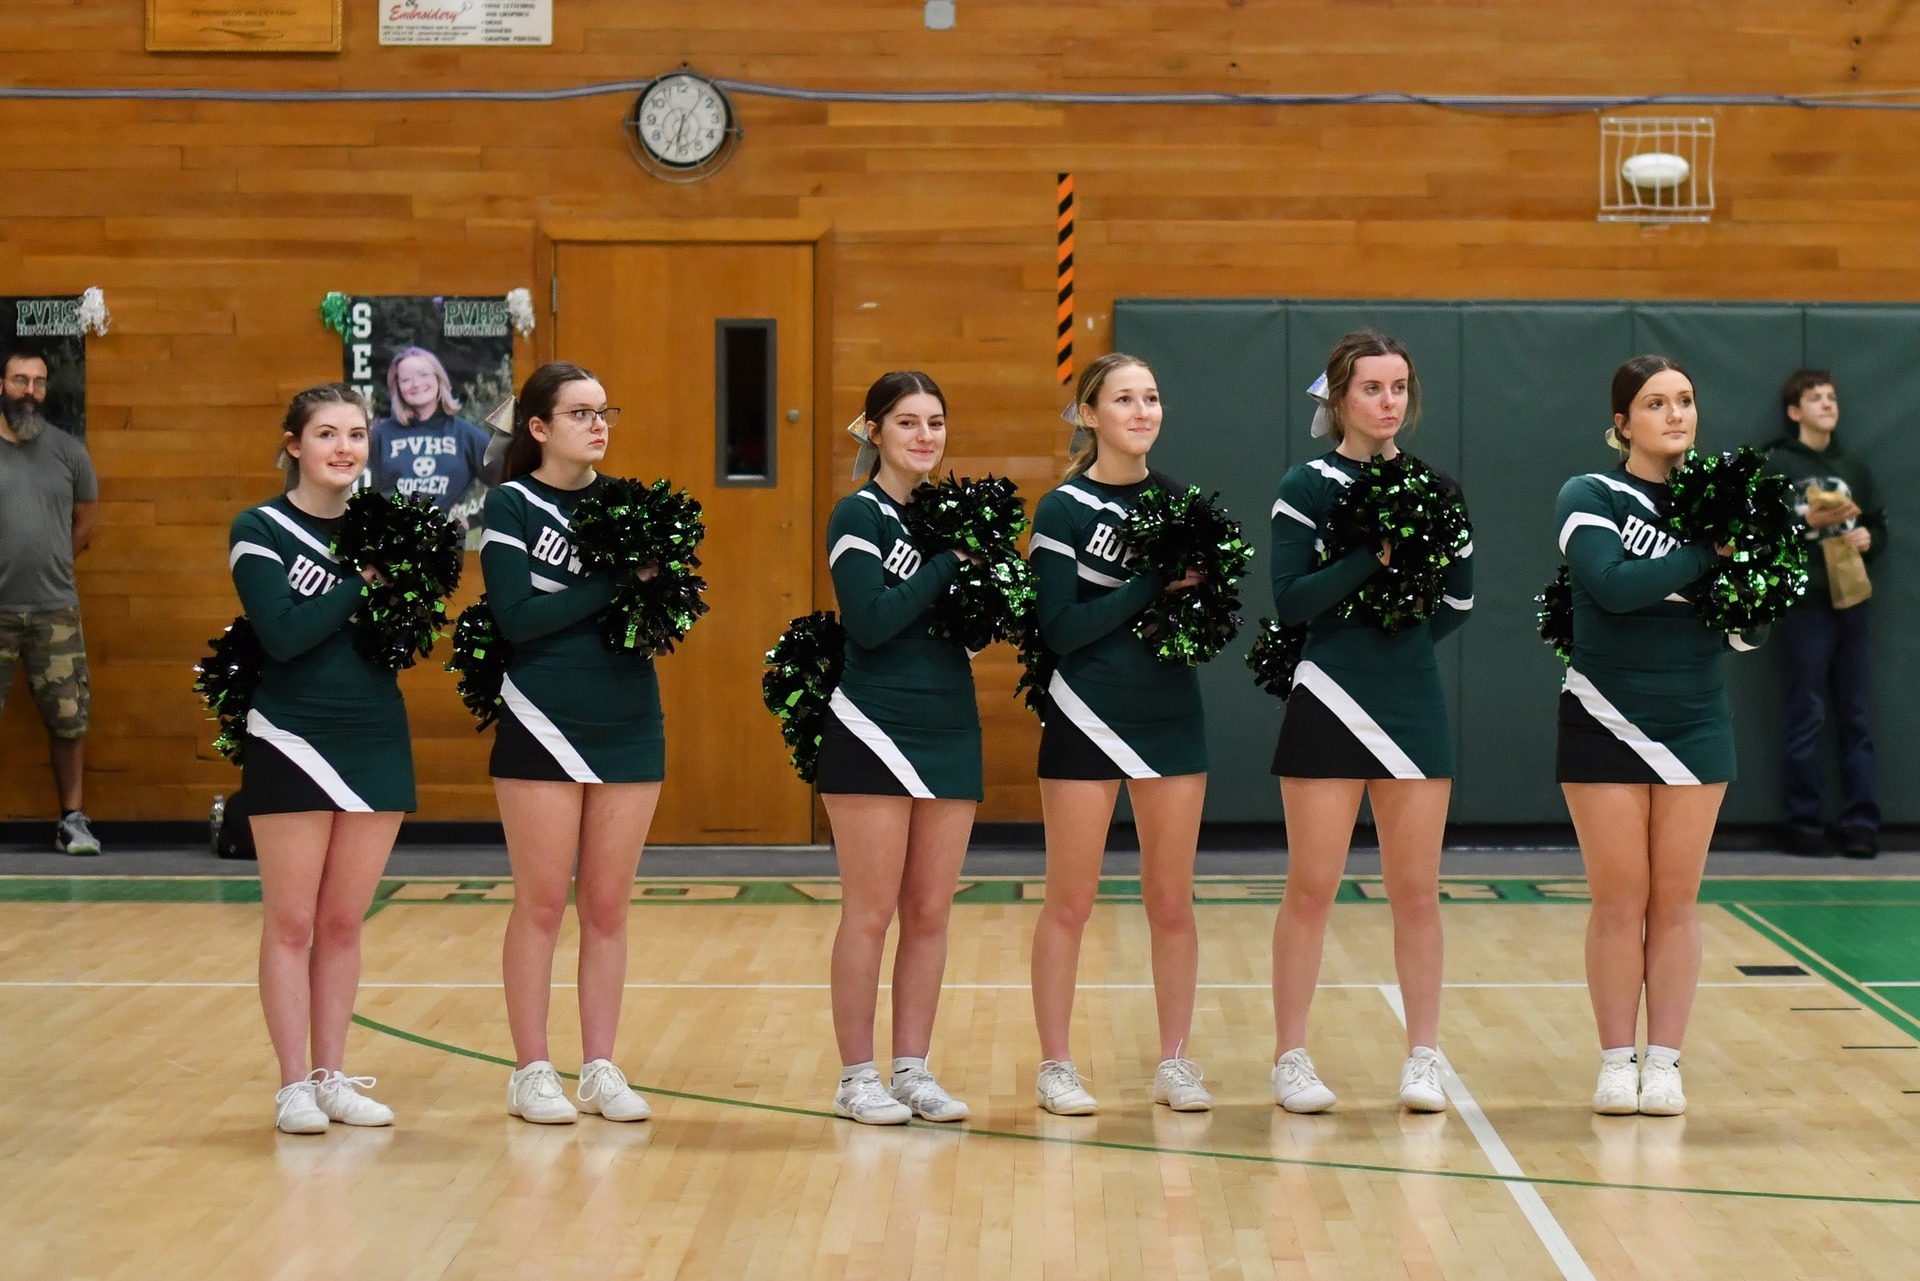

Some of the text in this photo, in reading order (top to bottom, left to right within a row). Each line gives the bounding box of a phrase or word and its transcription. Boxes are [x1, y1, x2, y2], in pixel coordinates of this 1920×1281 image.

[389, 5, 460, 23] Embroidery
[662, 87, 672, 98] 11
[676, 82, 689, 94] 12
[652, 98, 665, 109] 10
[705, 97, 714, 109] 2
[646, 114, 656, 125] 9
[711, 113, 719, 124] 3
[652, 130, 661, 141] 8
[706, 130, 714, 140] 4
[678, 145, 688, 156] 6
[694, 140, 703, 151] 5
[17, 300, 79, 325] PVHS
[444, 301, 509, 325] PVHS
[390, 436, 457, 459] PVHS
[396, 475, 450, 496] SOCCER
[1620, 514, 1682, 560] HOW
[386, 883, 1592, 900] HOER
